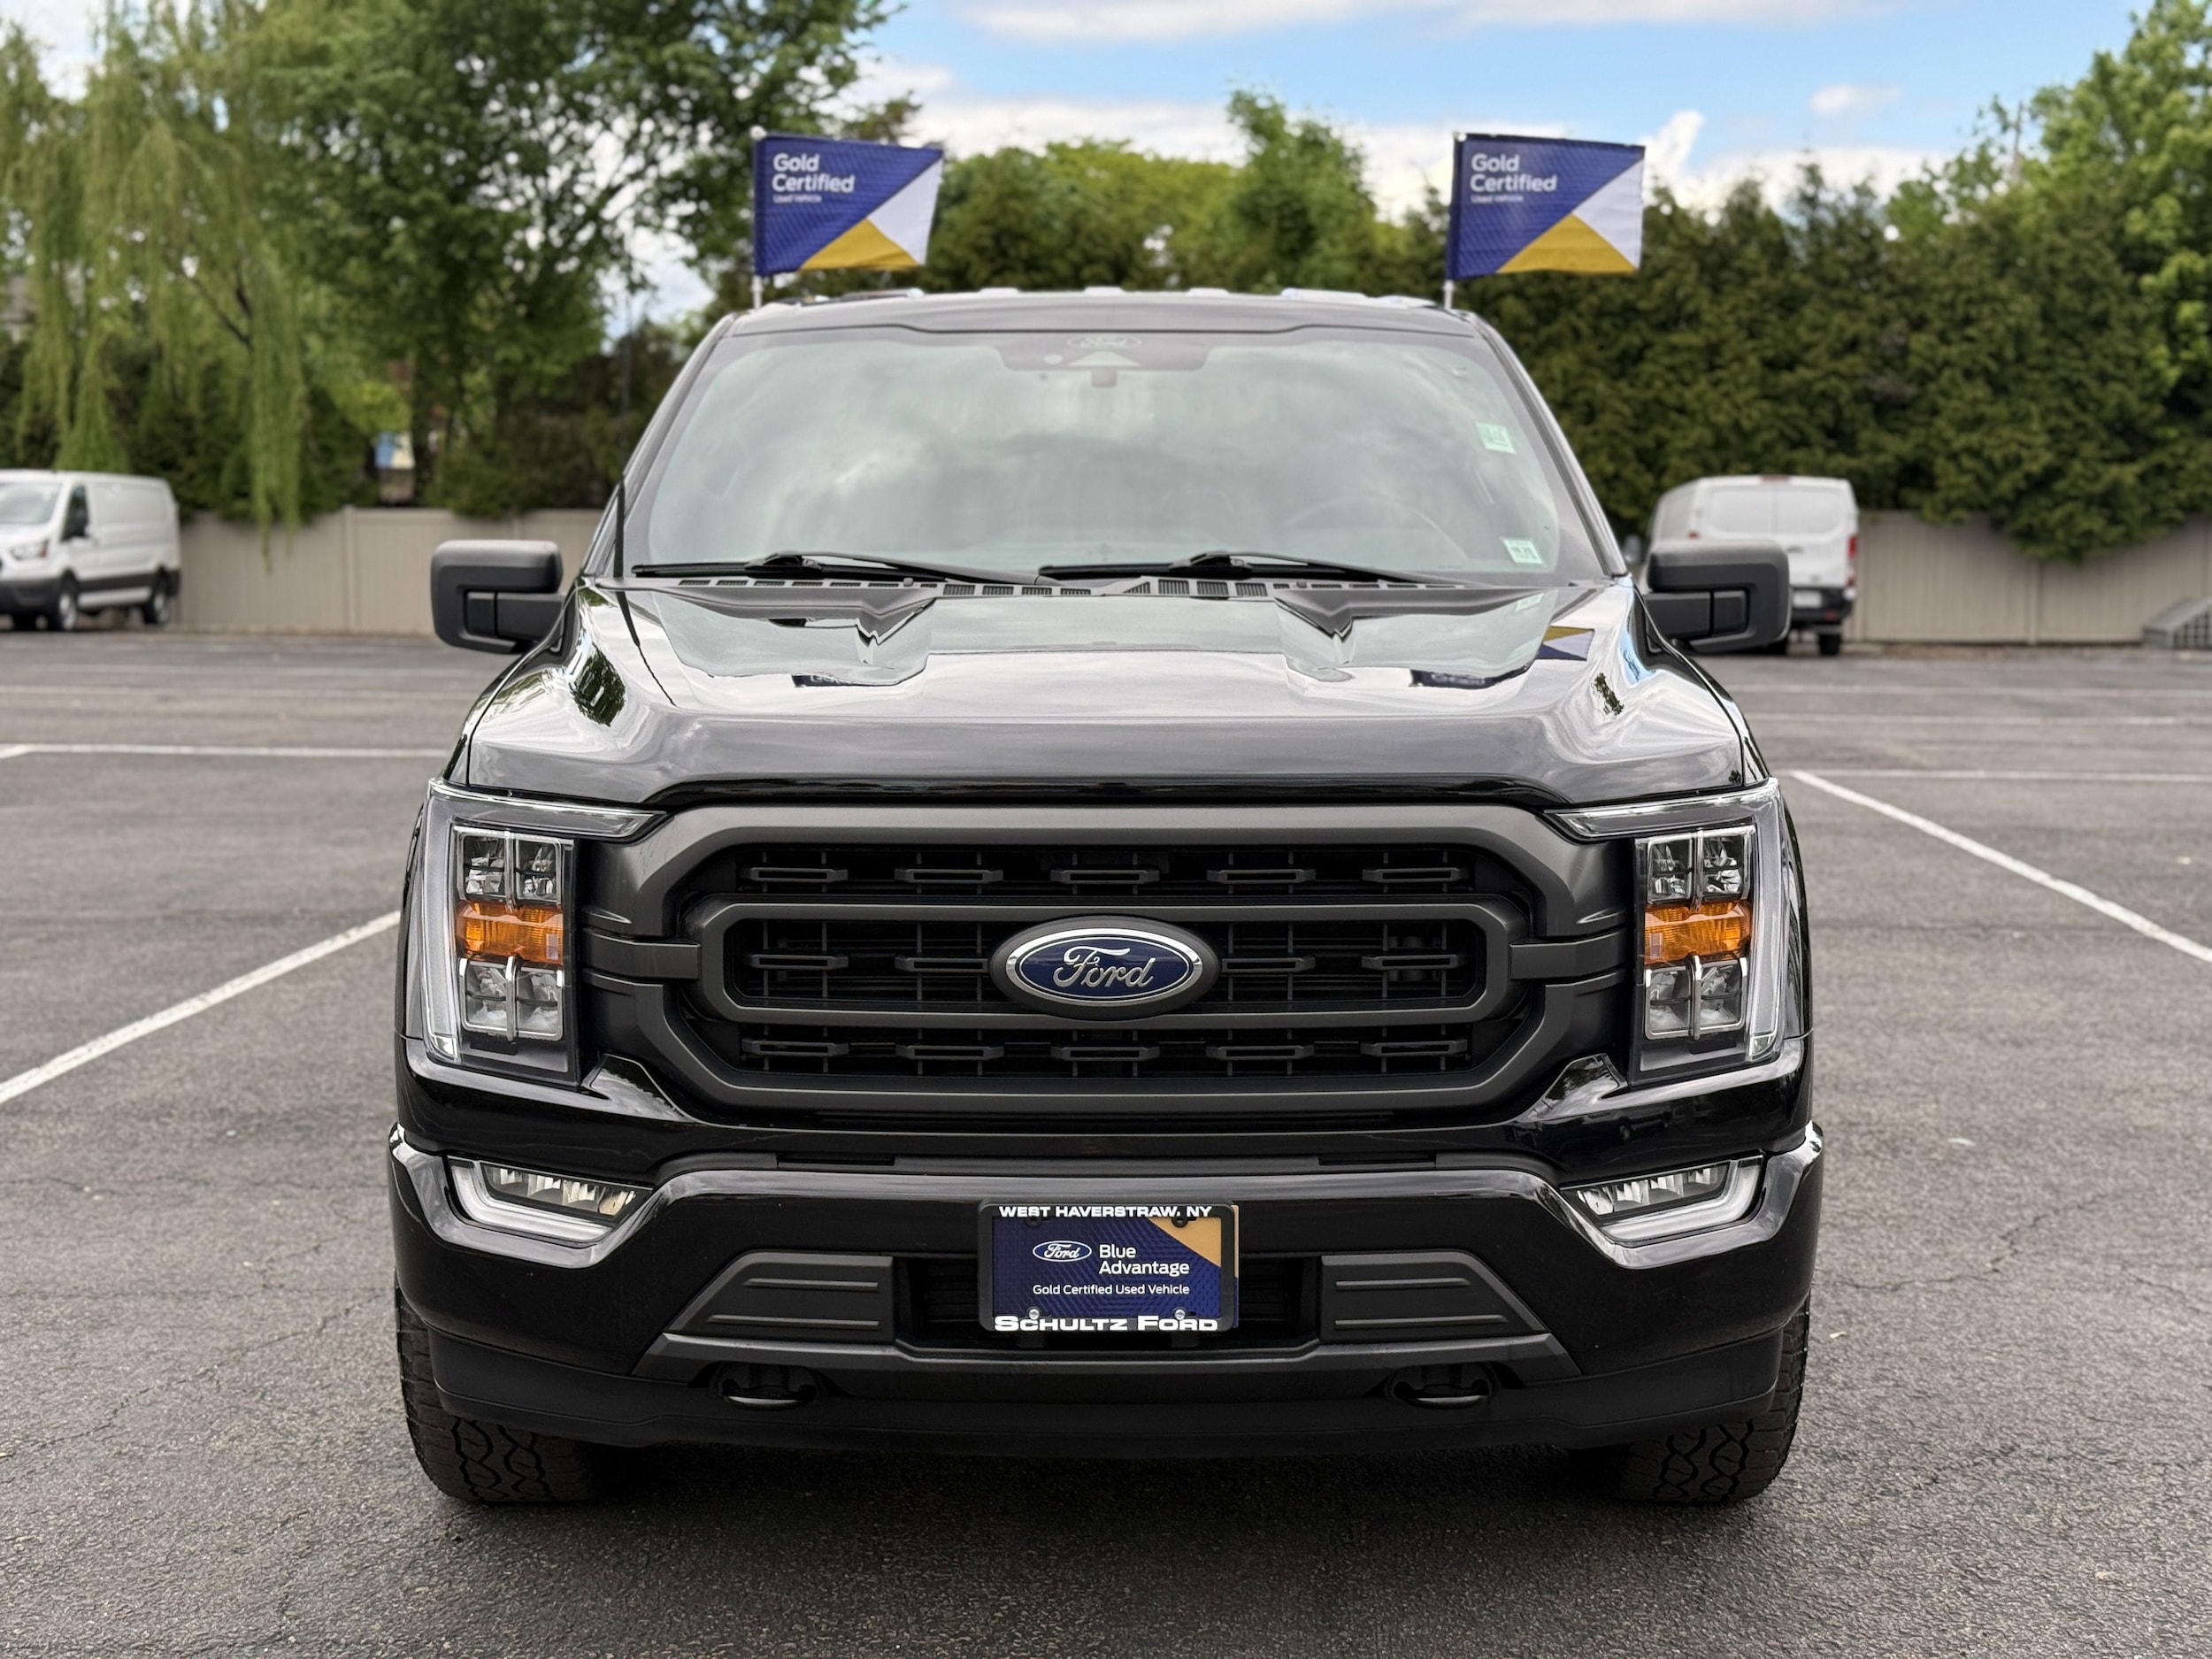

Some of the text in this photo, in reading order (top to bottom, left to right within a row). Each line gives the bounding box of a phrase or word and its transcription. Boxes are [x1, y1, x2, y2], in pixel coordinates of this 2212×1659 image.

[773, 152, 820, 172] Gold
[1471, 152, 1520, 172] Gold
[772, 173, 856, 193] Certified
[1470, 173, 1557, 192] Certified
[1053, 945, 1156, 987] Ford
[999, 1206, 1051, 1217] WEST
[1186, 1206, 1212, 1217] NY
[1043, 1243, 1081, 1259] Ford
[1099, 1244, 1136, 1258] Blue
[1098, 1261, 1190, 1277] Advantage
[1033, 1285, 1190, 1295] Gold Certified Used Vehicle
[995, 1315, 1218, 1331] SCHULTZ FORD
